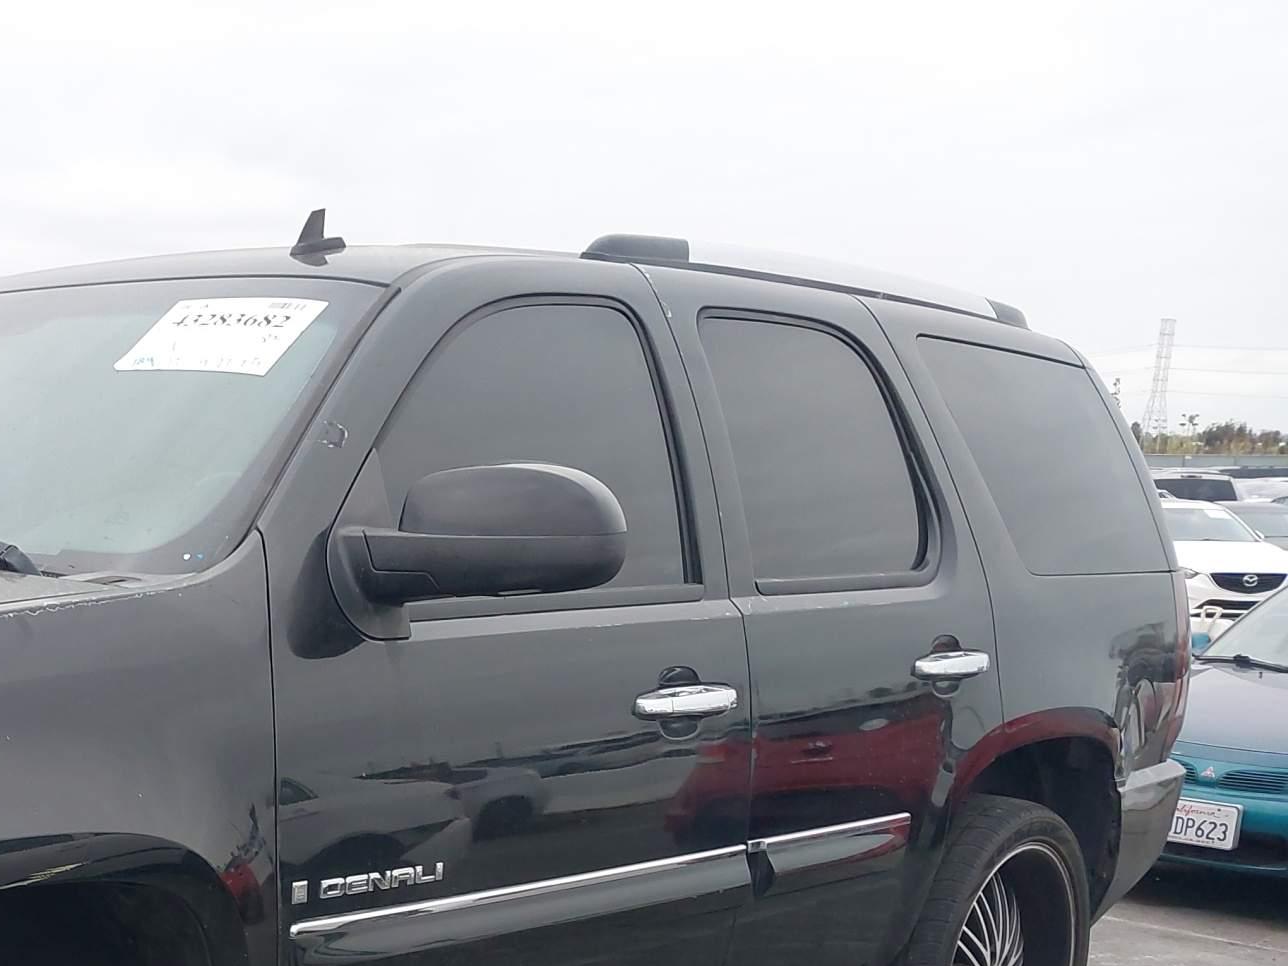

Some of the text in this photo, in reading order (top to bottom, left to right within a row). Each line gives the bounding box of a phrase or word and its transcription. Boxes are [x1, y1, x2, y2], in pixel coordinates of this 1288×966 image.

[173, 313, 291, 328] 43283682
[1173, 816, 1229, 842] DP623
[319, 861, 444, 899] DENALI
